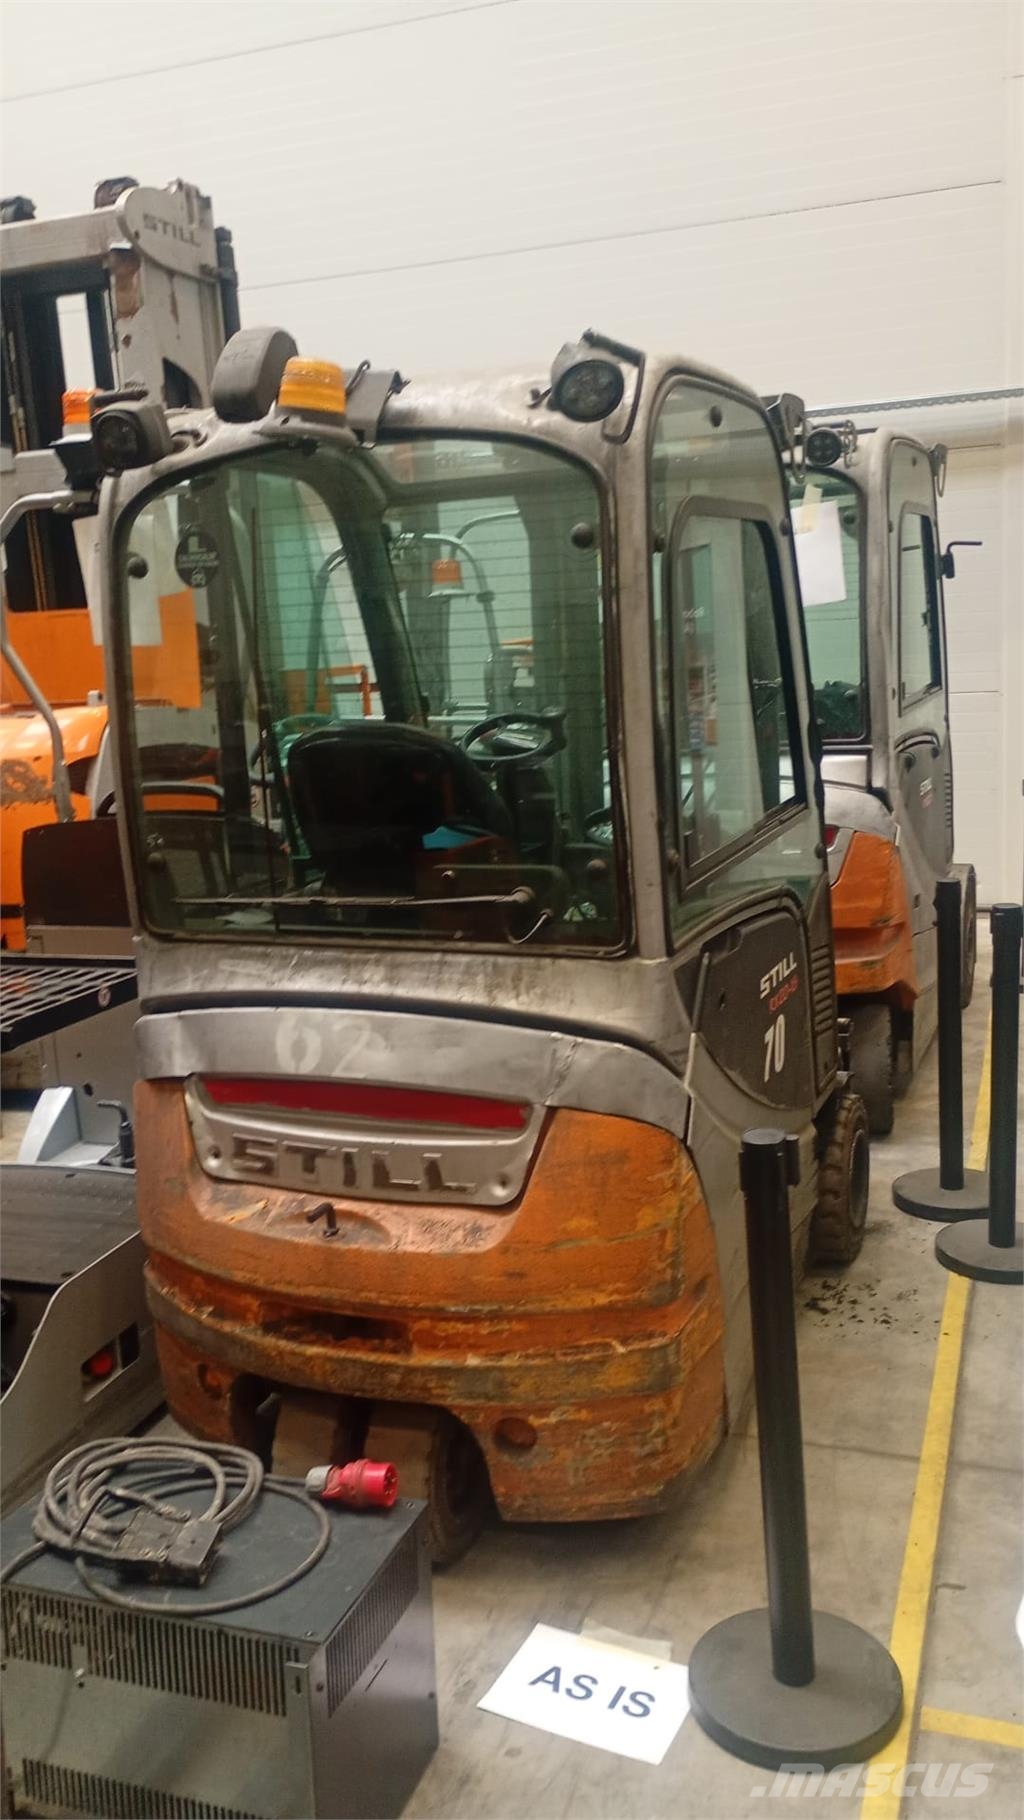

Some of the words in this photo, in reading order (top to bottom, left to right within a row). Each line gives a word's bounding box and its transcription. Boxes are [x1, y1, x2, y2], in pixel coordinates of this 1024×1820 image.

[143, 213, 201, 248] STILL
[760, 952, 797, 999] STILL
[764, 1014, 785, 1083] 70
[232, 1133, 476, 1193] STILL
[528, 1665, 598, 1700] AS
[608, 1686, 655, 1718] IS
